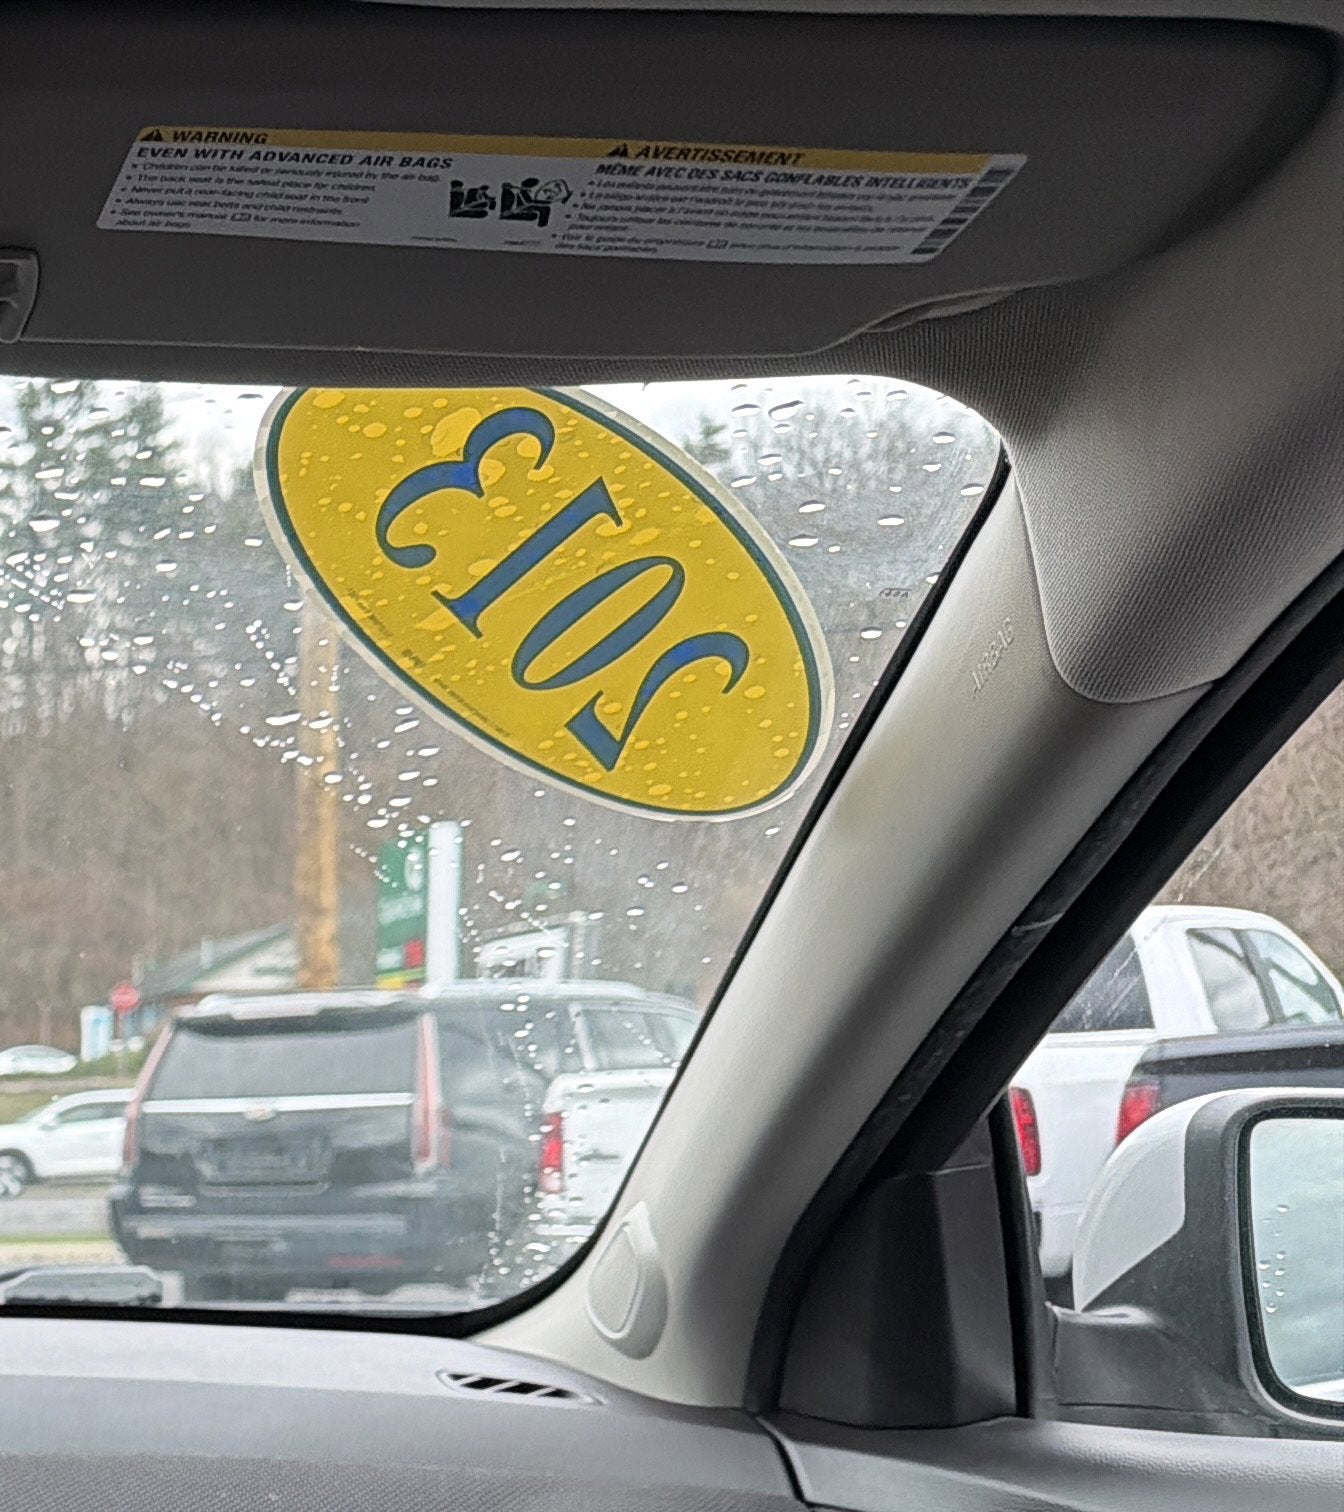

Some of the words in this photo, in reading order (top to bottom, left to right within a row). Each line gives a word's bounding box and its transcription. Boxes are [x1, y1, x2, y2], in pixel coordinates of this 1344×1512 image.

[172, 130, 269, 145] WARNING
[137, 147, 188, 158] EVEN
[194, 148, 244, 160] WITH
[248, 150, 354, 165] ADVANCED
[358, 155, 395, 168] AIR
[398, 156, 453, 170] BAGS
[635, 144, 807, 167] AVERTISSEMENT
[646, 165, 686, 179] AVEC
[687, 166, 720, 180] DES
[720, 168, 763, 183] SACS
[764, 170, 867, 187] GONFLABLES
[866, 174, 973, 190] INTELLIGENTS
